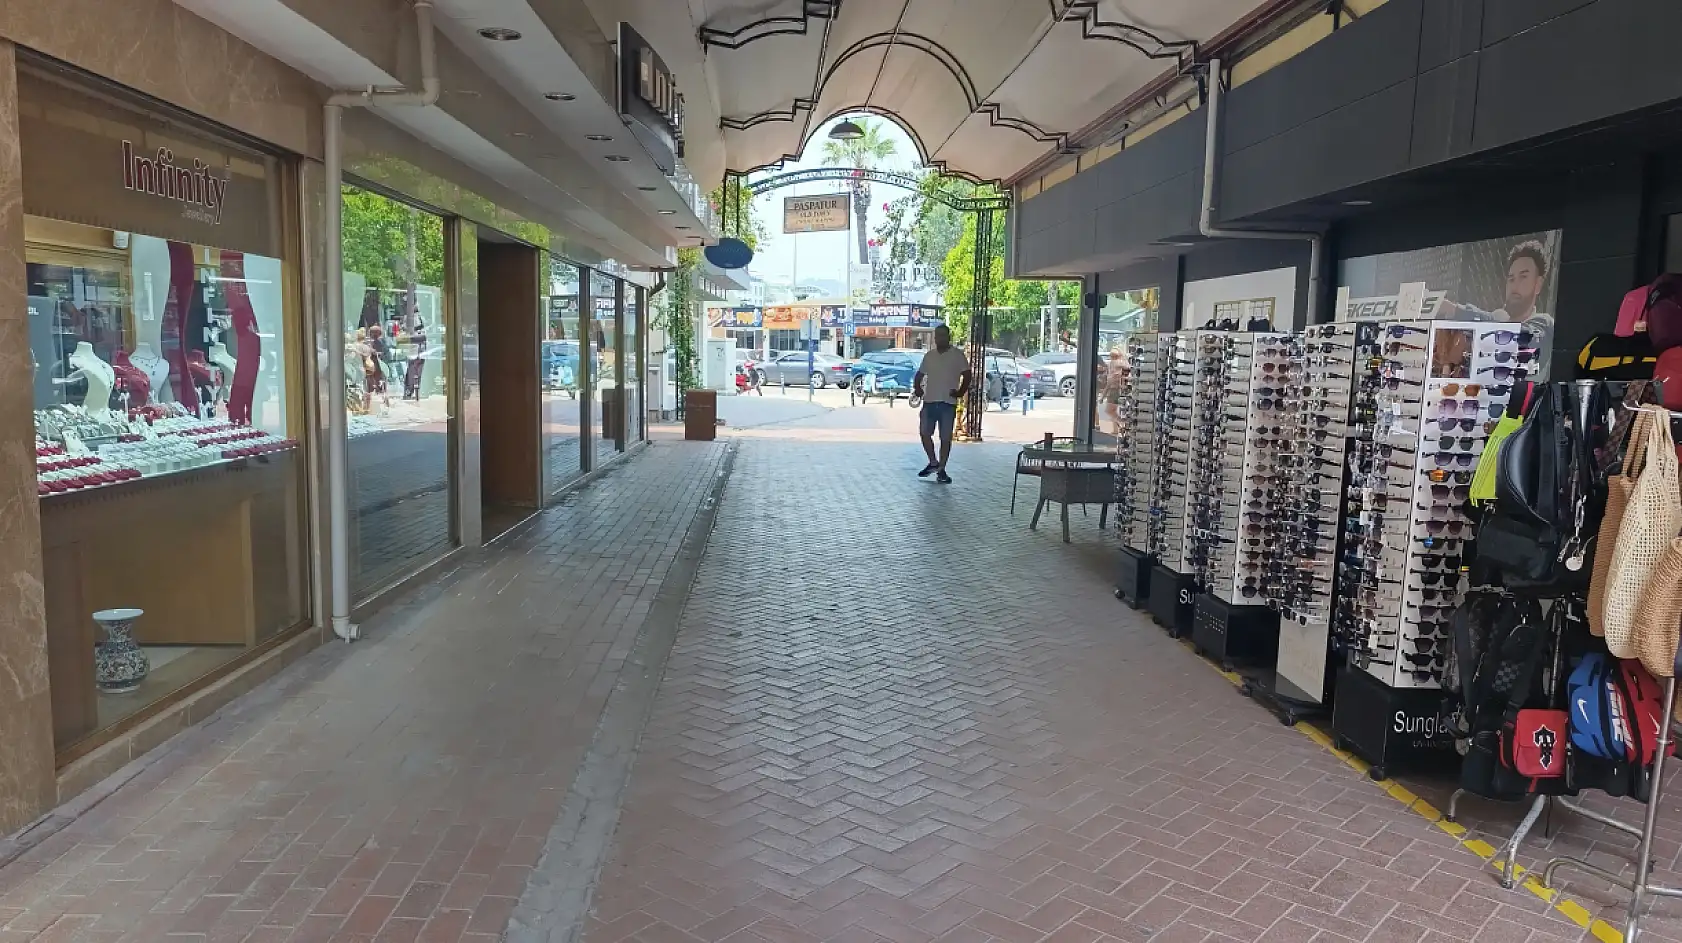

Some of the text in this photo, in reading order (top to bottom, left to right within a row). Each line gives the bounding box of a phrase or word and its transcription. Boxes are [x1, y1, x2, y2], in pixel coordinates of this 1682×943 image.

[121, 139, 227, 225] Infinity
[794, 200, 837, 211] PASPATUR
[871, 305, 910, 316] MARINE
